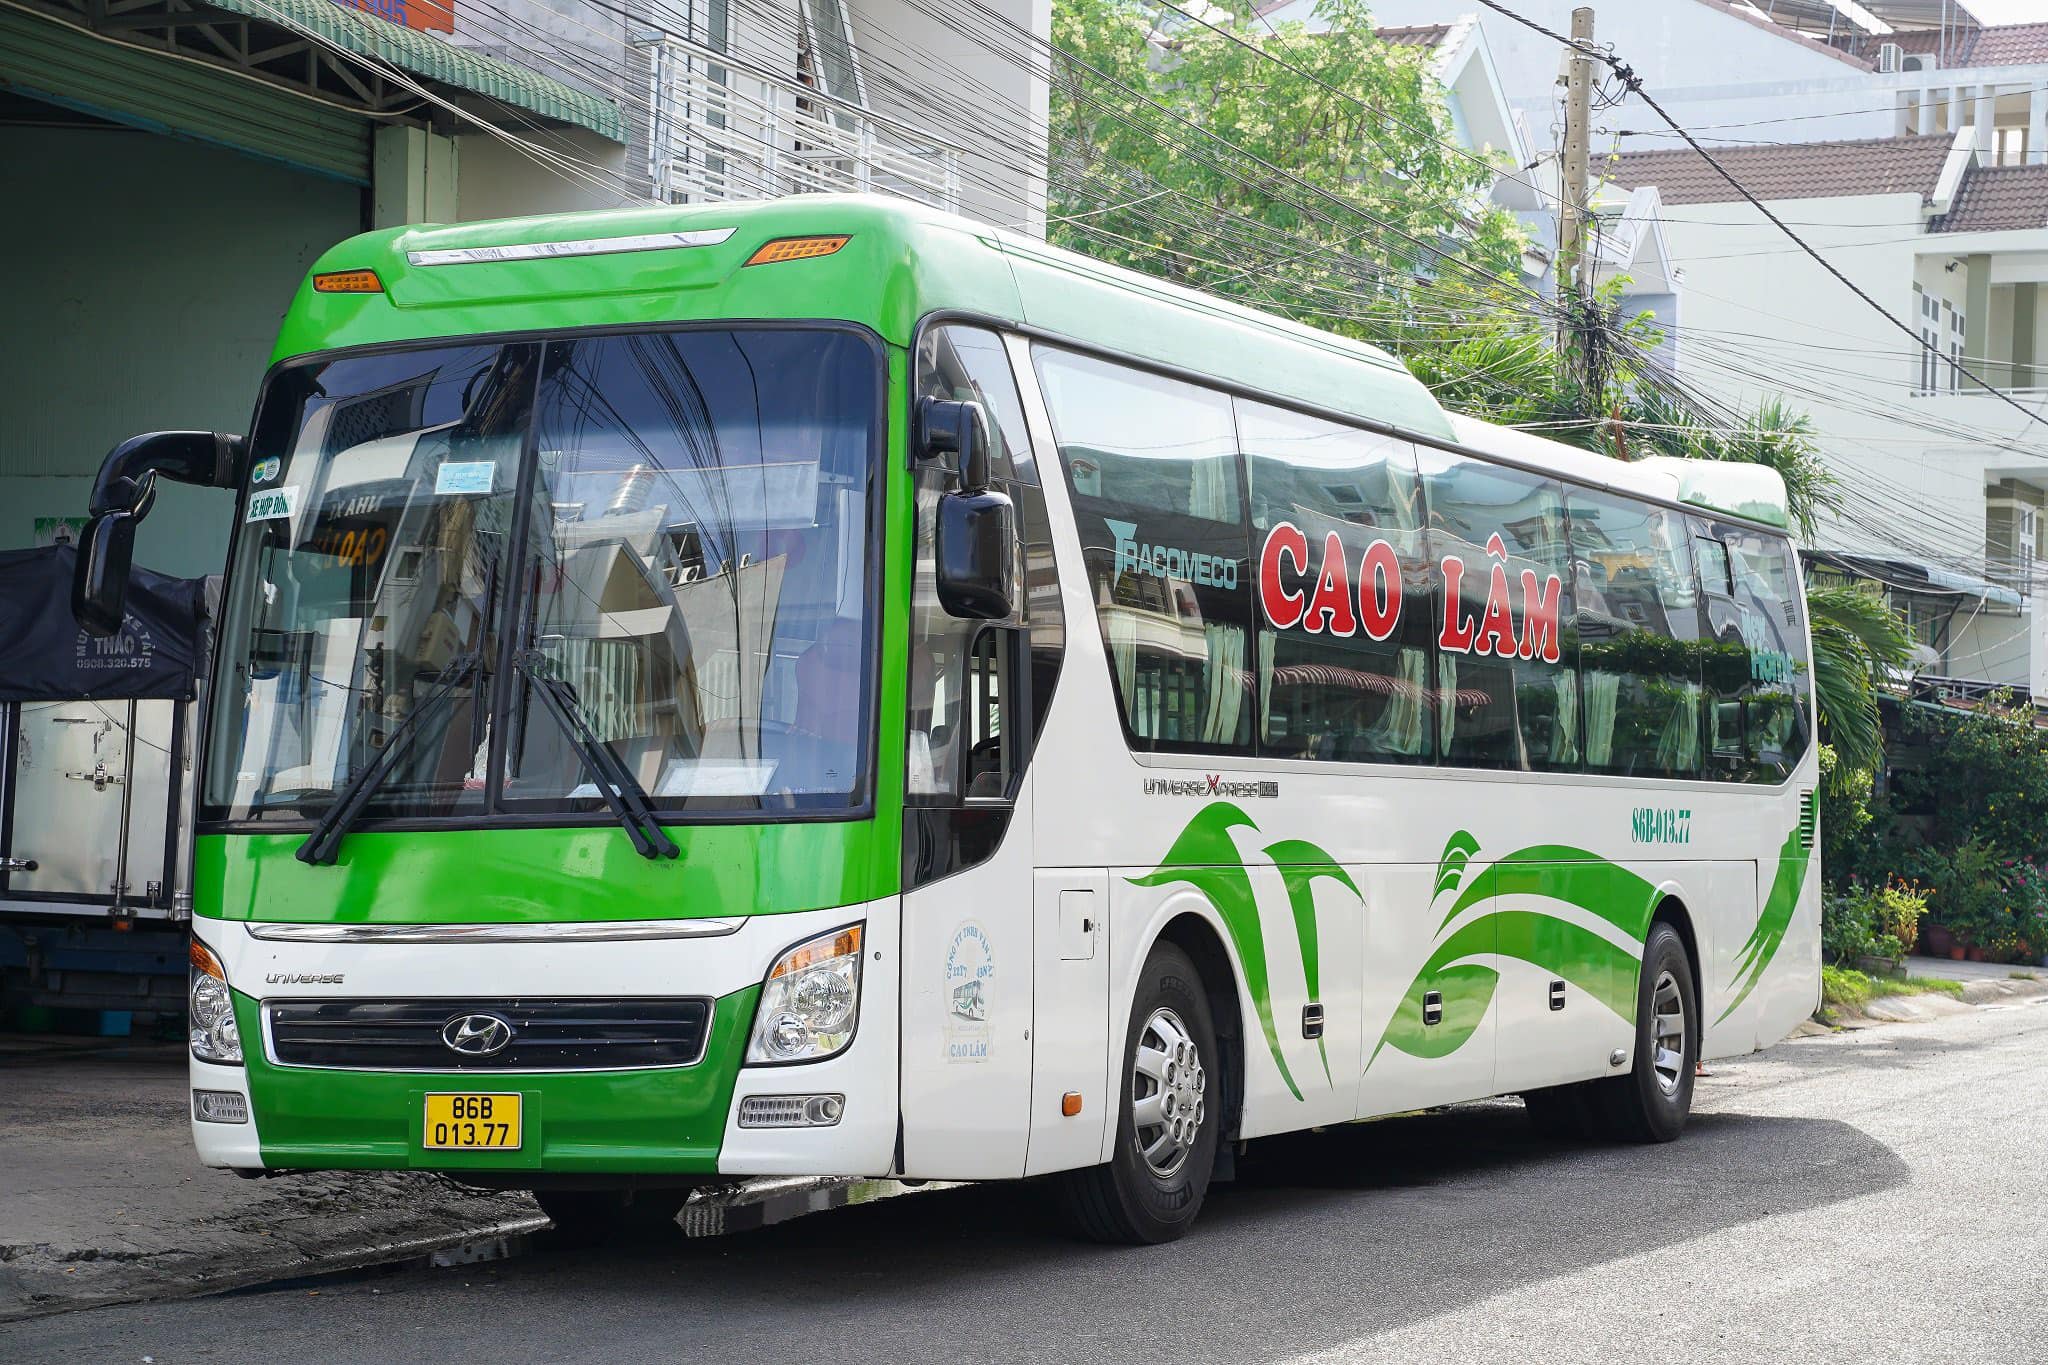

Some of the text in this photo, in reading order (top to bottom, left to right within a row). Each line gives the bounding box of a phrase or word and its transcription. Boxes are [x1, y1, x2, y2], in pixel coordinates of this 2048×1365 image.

[273, 492, 295, 514] ĐỒN
[1104, 517, 1238, 591] TRACOMECO
[1259, 521, 1562, 664] CAO LÂM
[122, 613, 143, 631] XE
[1631, 807, 1691, 844] 86B-013.77
[265, 973, 345, 985] UNIVERSE
[950, 1043, 968, 1058] CAO
[452, 1097, 493, 1119] 86B
[435, 1123, 510, 1146] 013.77
